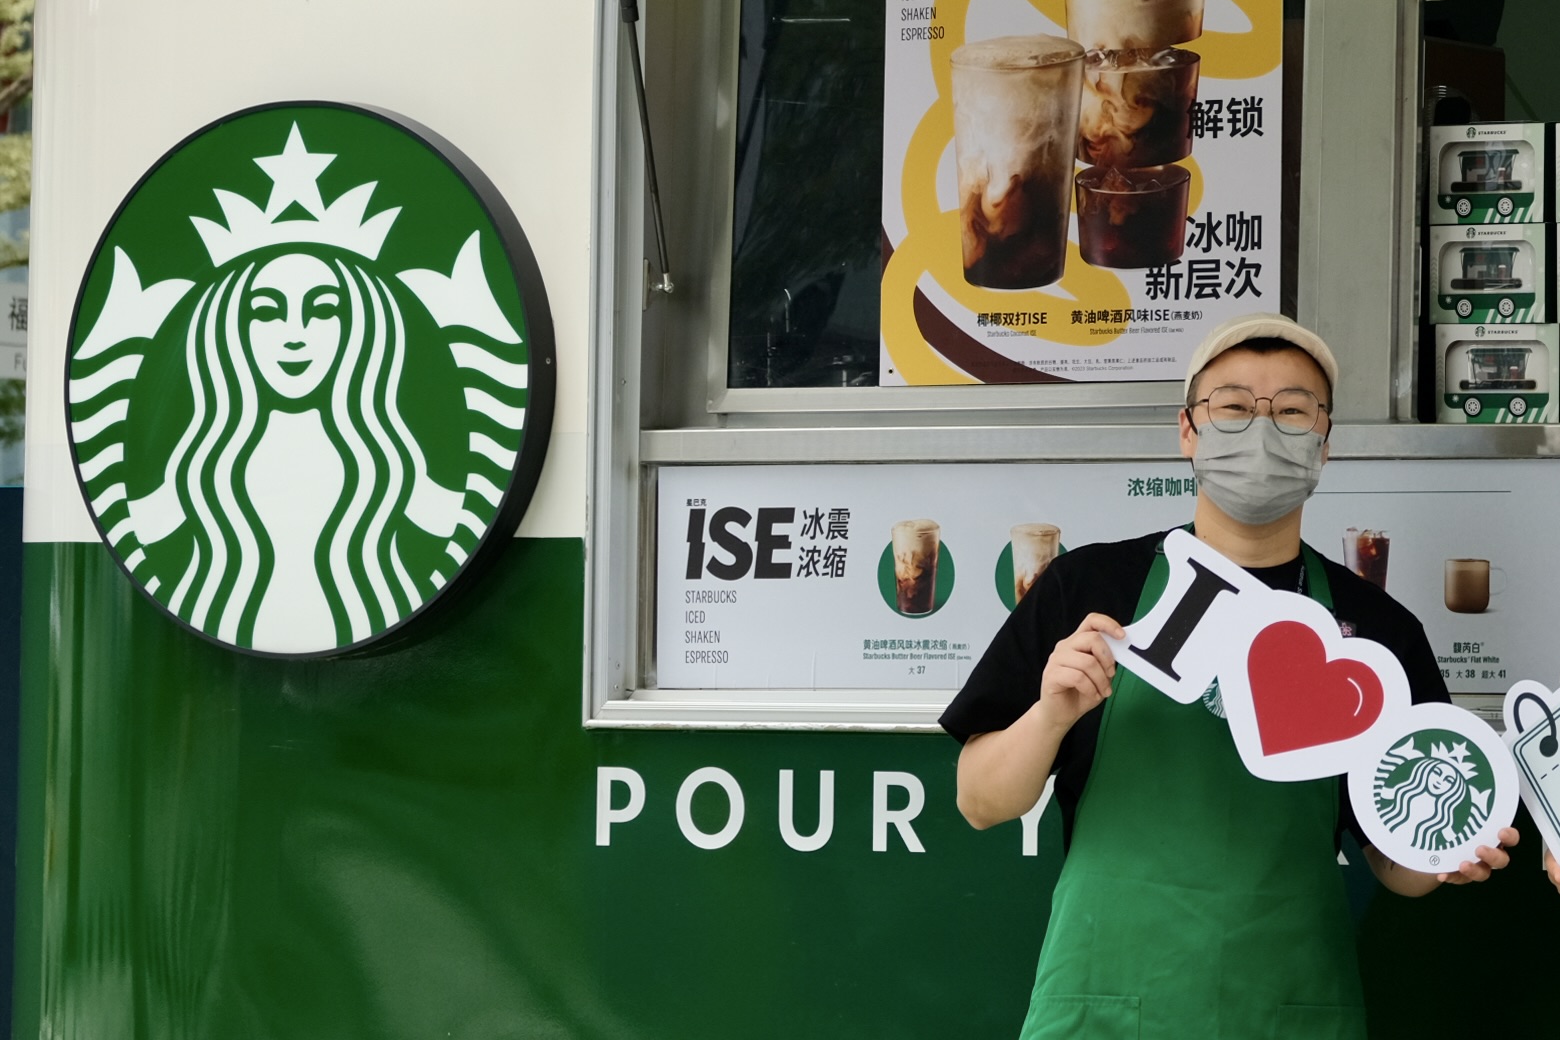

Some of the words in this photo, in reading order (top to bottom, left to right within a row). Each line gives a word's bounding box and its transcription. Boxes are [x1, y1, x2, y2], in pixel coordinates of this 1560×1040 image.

[901, 7, 937, 21] SHAKEN
[901, 26, 945, 41] ESPRESSO
[1187, 96, 1264, 139] 解锁
[1186, 211, 1262, 253] 冰咖
[1145, 257, 1262, 301] 新层次
[977, 312, 1048, 328] 椰椰双打ISE
[800, 507, 850, 540] 冰震
[686, 506, 796, 581] ISE
[797, 545, 848, 579] 浓缩
[685, 590, 737, 603] STARBUCKS
[685, 611, 705, 623] ICED
[1128, 557, 1240, 682] I
[685, 631, 720, 643] SHAKEN
[685, 651, 728, 663] ESPRESSO
[863, 652, 890, 660] Starbucks
[892, 652, 909, 660] Butter
[910, 652, 922, 660] Beer
[924, 652, 947, 660] Flavored
[948, 652, 956, 660] ISE
[917, 666, 925, 674] 37
[1456, 670, 1463, 679] 大
[1465, 669, 1475, 678] 38
[1481, 670, 1495, 679] 超大
[1498, 669, 1506, 678] 41
[596, 766, 926, 853] POUR
